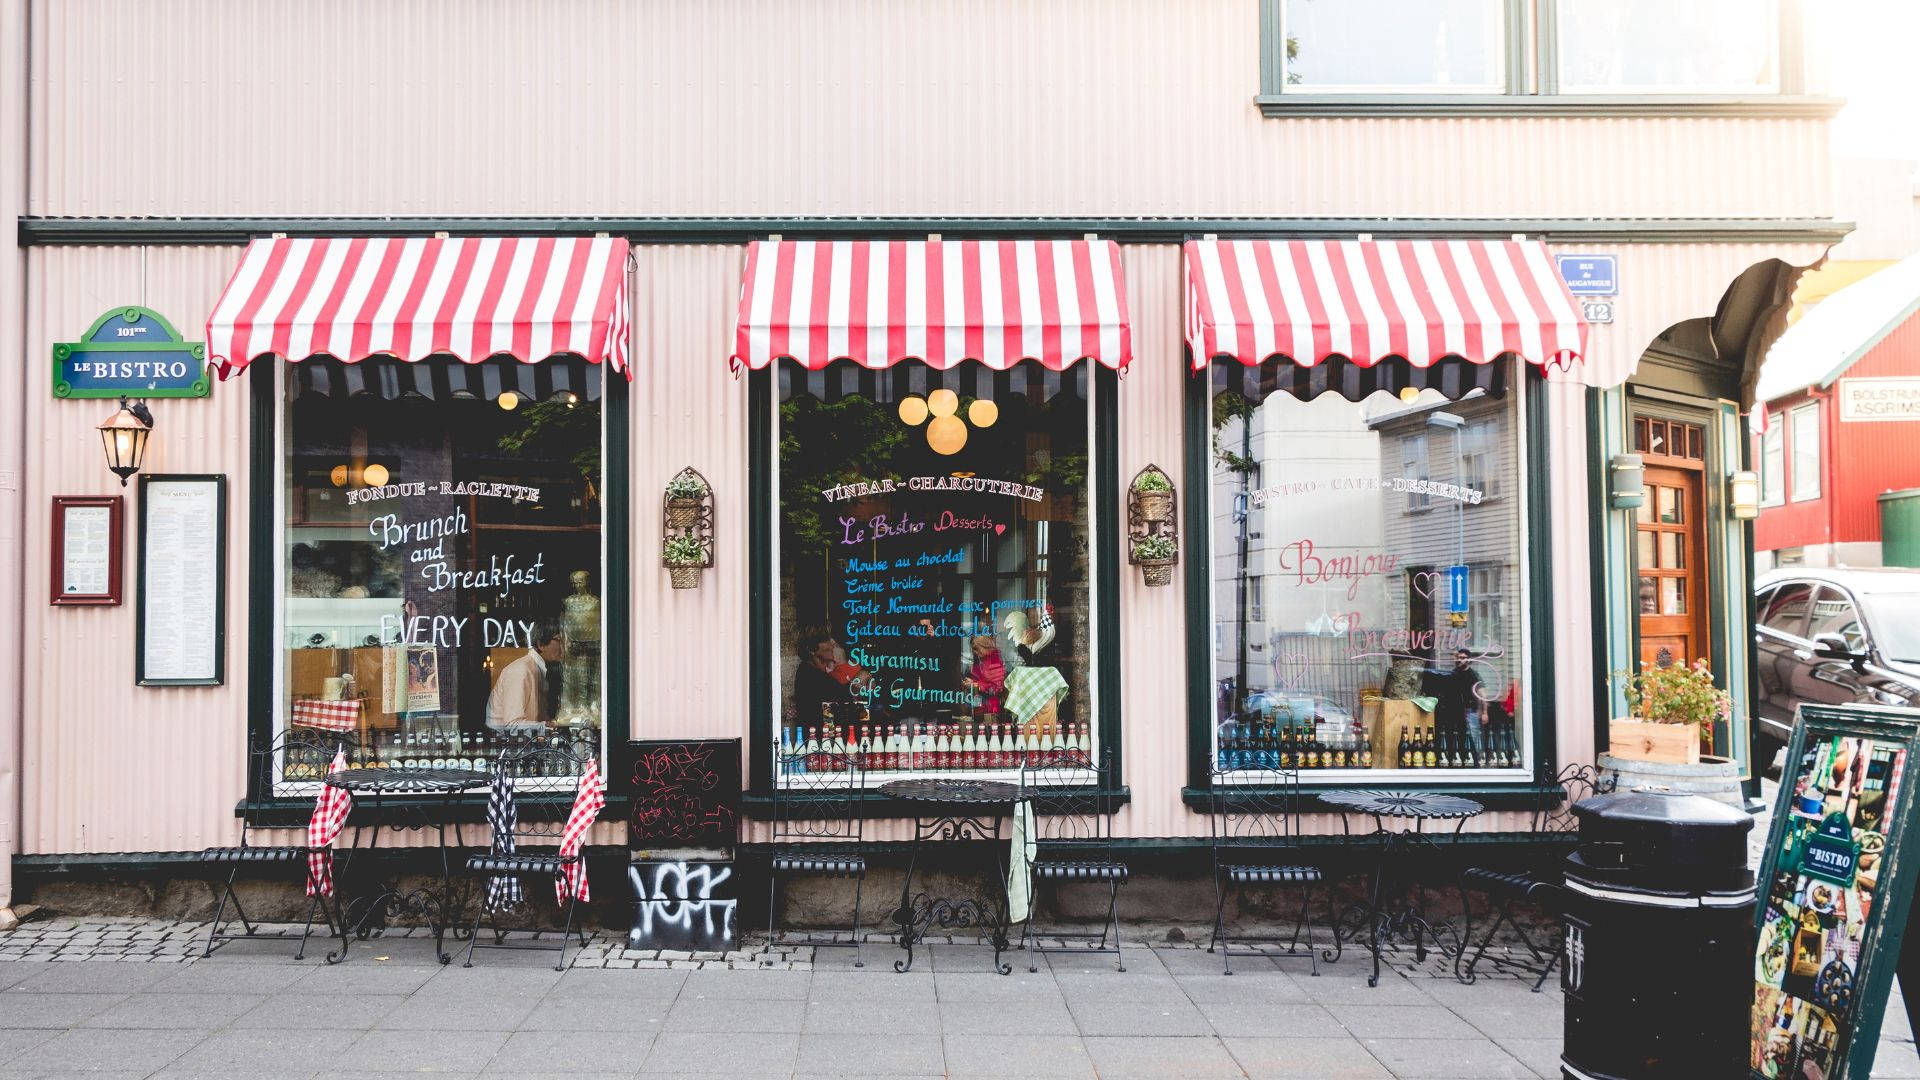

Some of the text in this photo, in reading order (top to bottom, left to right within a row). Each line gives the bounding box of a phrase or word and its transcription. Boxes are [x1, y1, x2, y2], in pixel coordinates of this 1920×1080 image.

[1587, 304, 1609, 320] 12
[74, 361, 187, 378] LE BISTRO
[345, 481, 541, 505] FONDUE RACLETTE
[909, 476, 1044, 502] CHARCUTERIE
[1251, 479, 1318, 505] BISTRO
[1392, 477, 1484, 505] DESSERTS
[369, 505, 469, 551] Brunch
[838, 510, 993, 545] Le Bistro Desserts
[410, 538, 445, 563] and
[844, 547, 966, 574] Mousse au chocolat
[421, 552, 546, 599] Breakfast
[1278, 539, 1401, 602] Bonjour
[844, 578, 885, 594] Crème
[842, 599, 881, 616] Torte
[886, 595, 953, 615] Normande
[958, 601, 984, 612] aux
[380, 614, 535, 649] EVERY DAY
[846, 615, 999, 645] Gateau au chocolat
[849, 676, 982, 709] Café Gourmand
[1814, 849, 1851, 868] BISTRO
